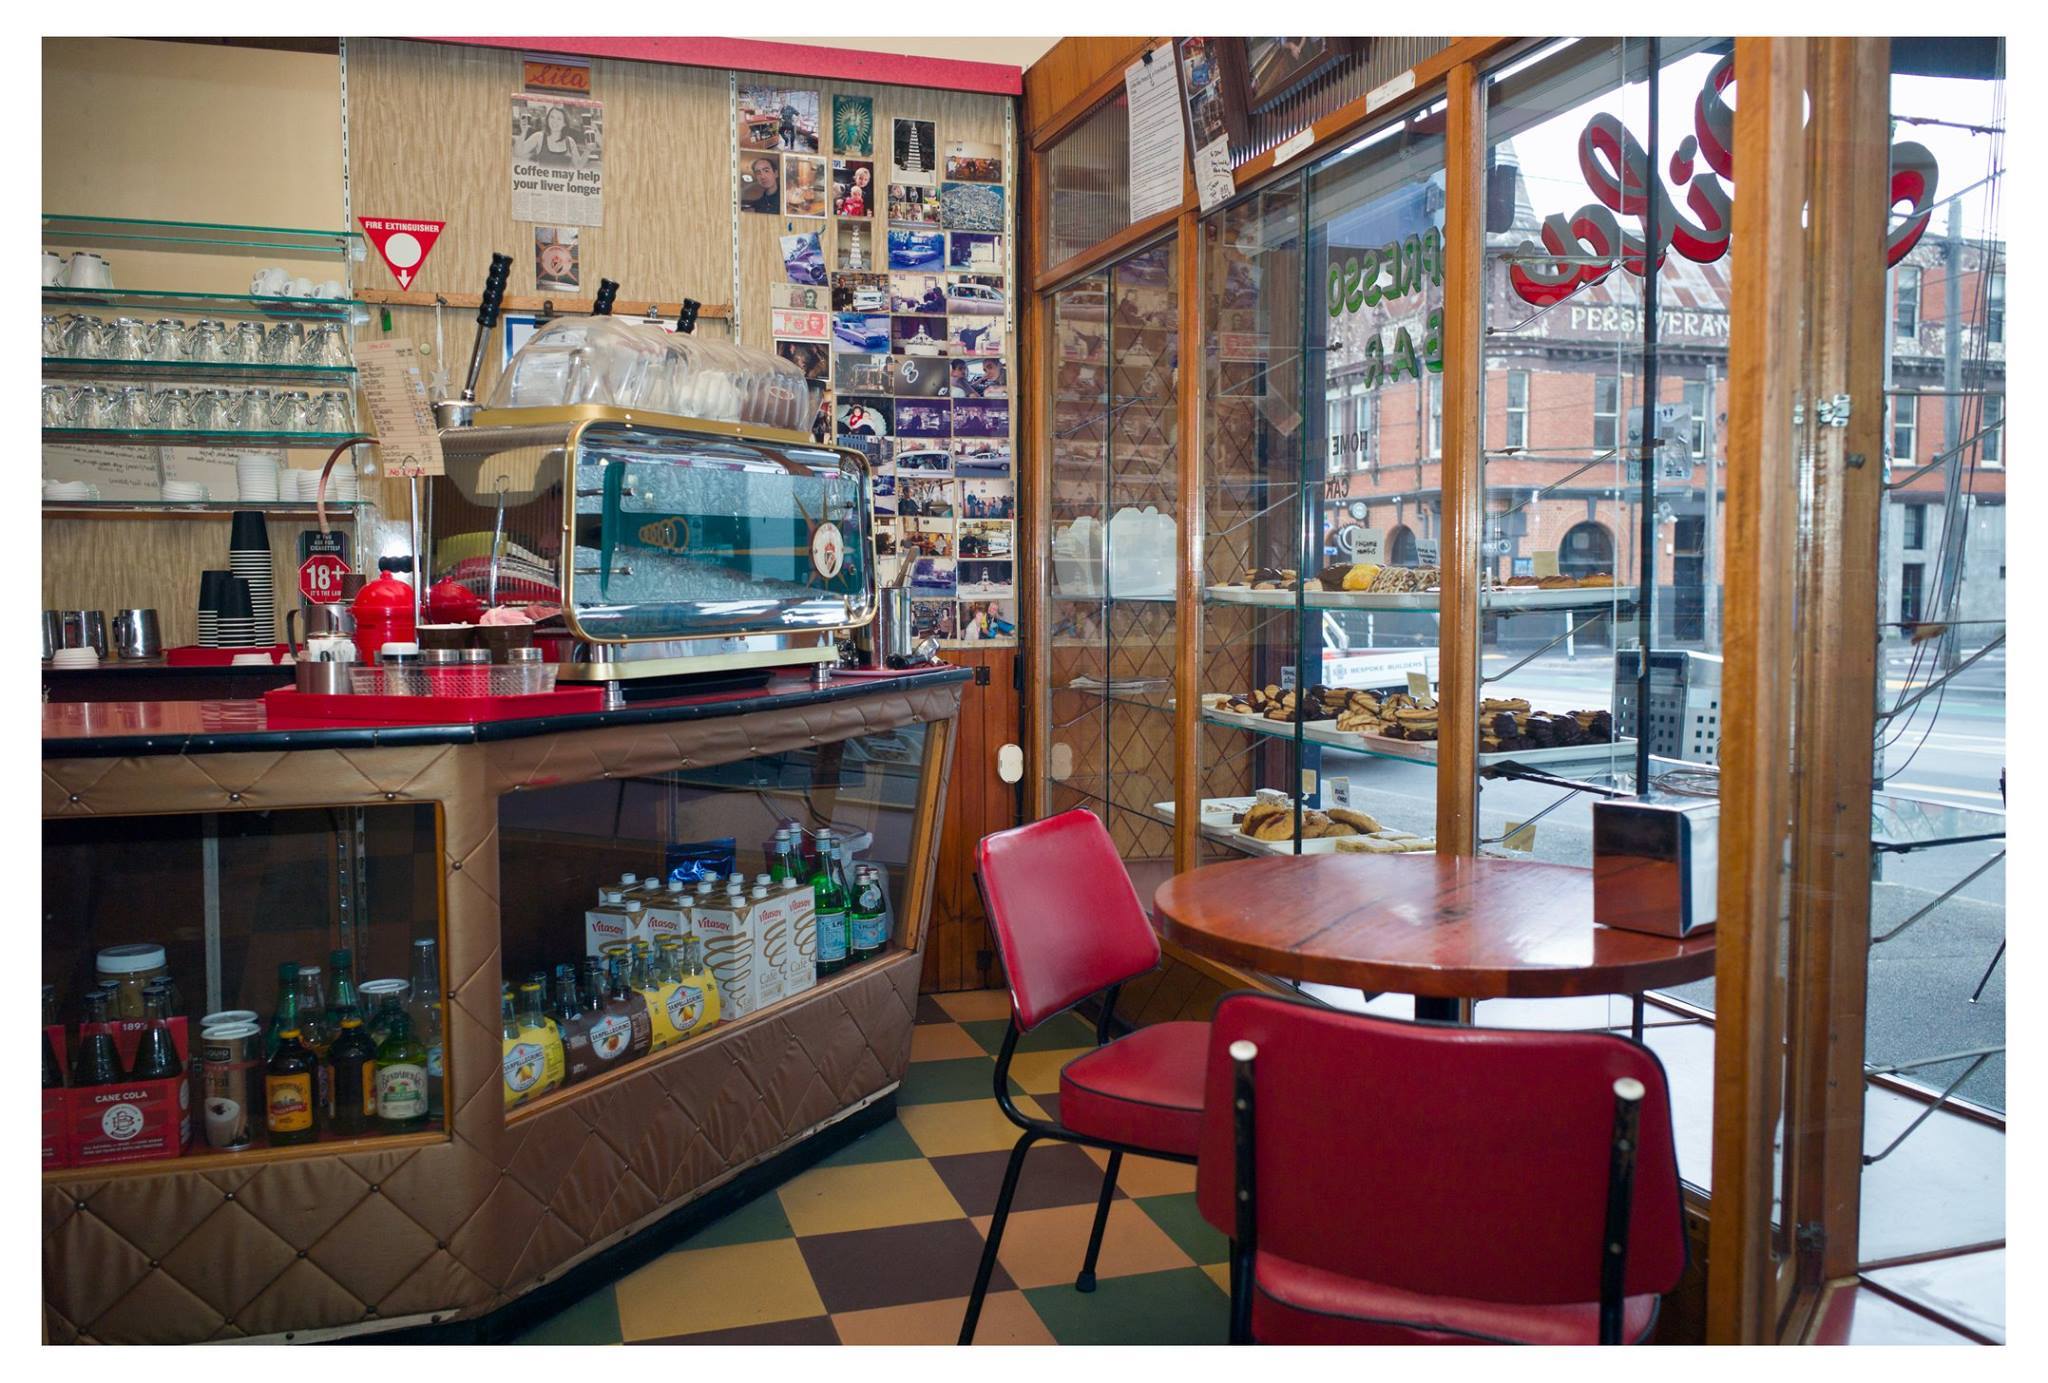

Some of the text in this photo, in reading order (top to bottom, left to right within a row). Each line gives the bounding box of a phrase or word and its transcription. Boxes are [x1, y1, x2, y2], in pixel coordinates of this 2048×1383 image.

[527, 64, 588, 88] Sila
[513, 164, 600, 184] Coffee may help
[513, 179, 601, 197] your liver longer
[365, 221, 439, 233] FIRE EXTINGUISHER
[1571, 306, 1731, 337] PERSEVERAN
[306, 564, 345, 590] 18+
[1350, 661, 1423, 673] BESPOKE BUILDERS
[789, 899, 812, 912] Vitasoy
[759, 908, 783, 923] Vitasoy
[592, 920, 625, 935] Vitasoy
[648, 916, 679, 931] Vitasoy
[698, 916, 730, 932] Vitasoy
[592, 1022, 630, 1040] SANPELLEGRINO
[95, 1090, 148, 1103] CANE COLA
